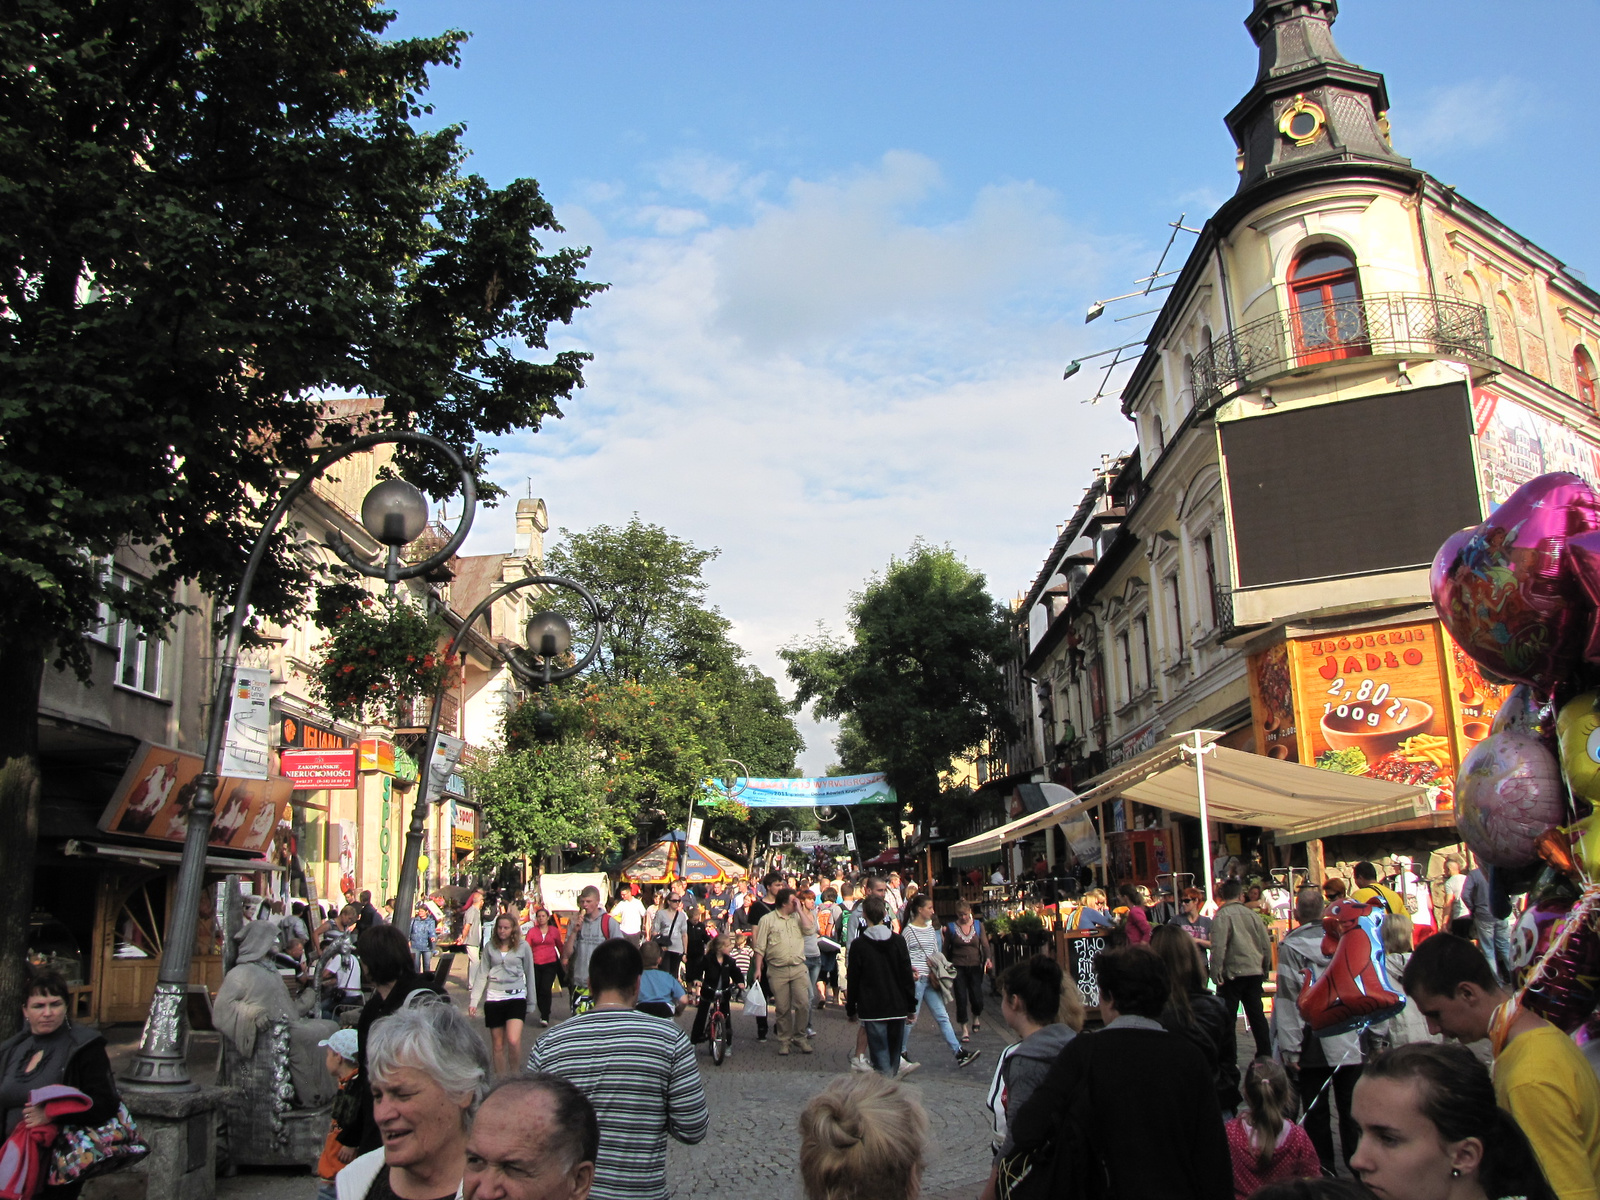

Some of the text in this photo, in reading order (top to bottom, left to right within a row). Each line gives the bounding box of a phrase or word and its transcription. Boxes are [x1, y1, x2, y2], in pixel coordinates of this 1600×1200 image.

[1311, 629, 1425, 656] ZBÓJECKIE
[1318, 648, 1423, 680] JADŁO
[1323, 702, 1380, 727] 100g
[1327, 677, 1409, 725] 2,80 zł
[380, 776, 391, 908] SPORT
[1074, 937, 1105, 954] PIWO
